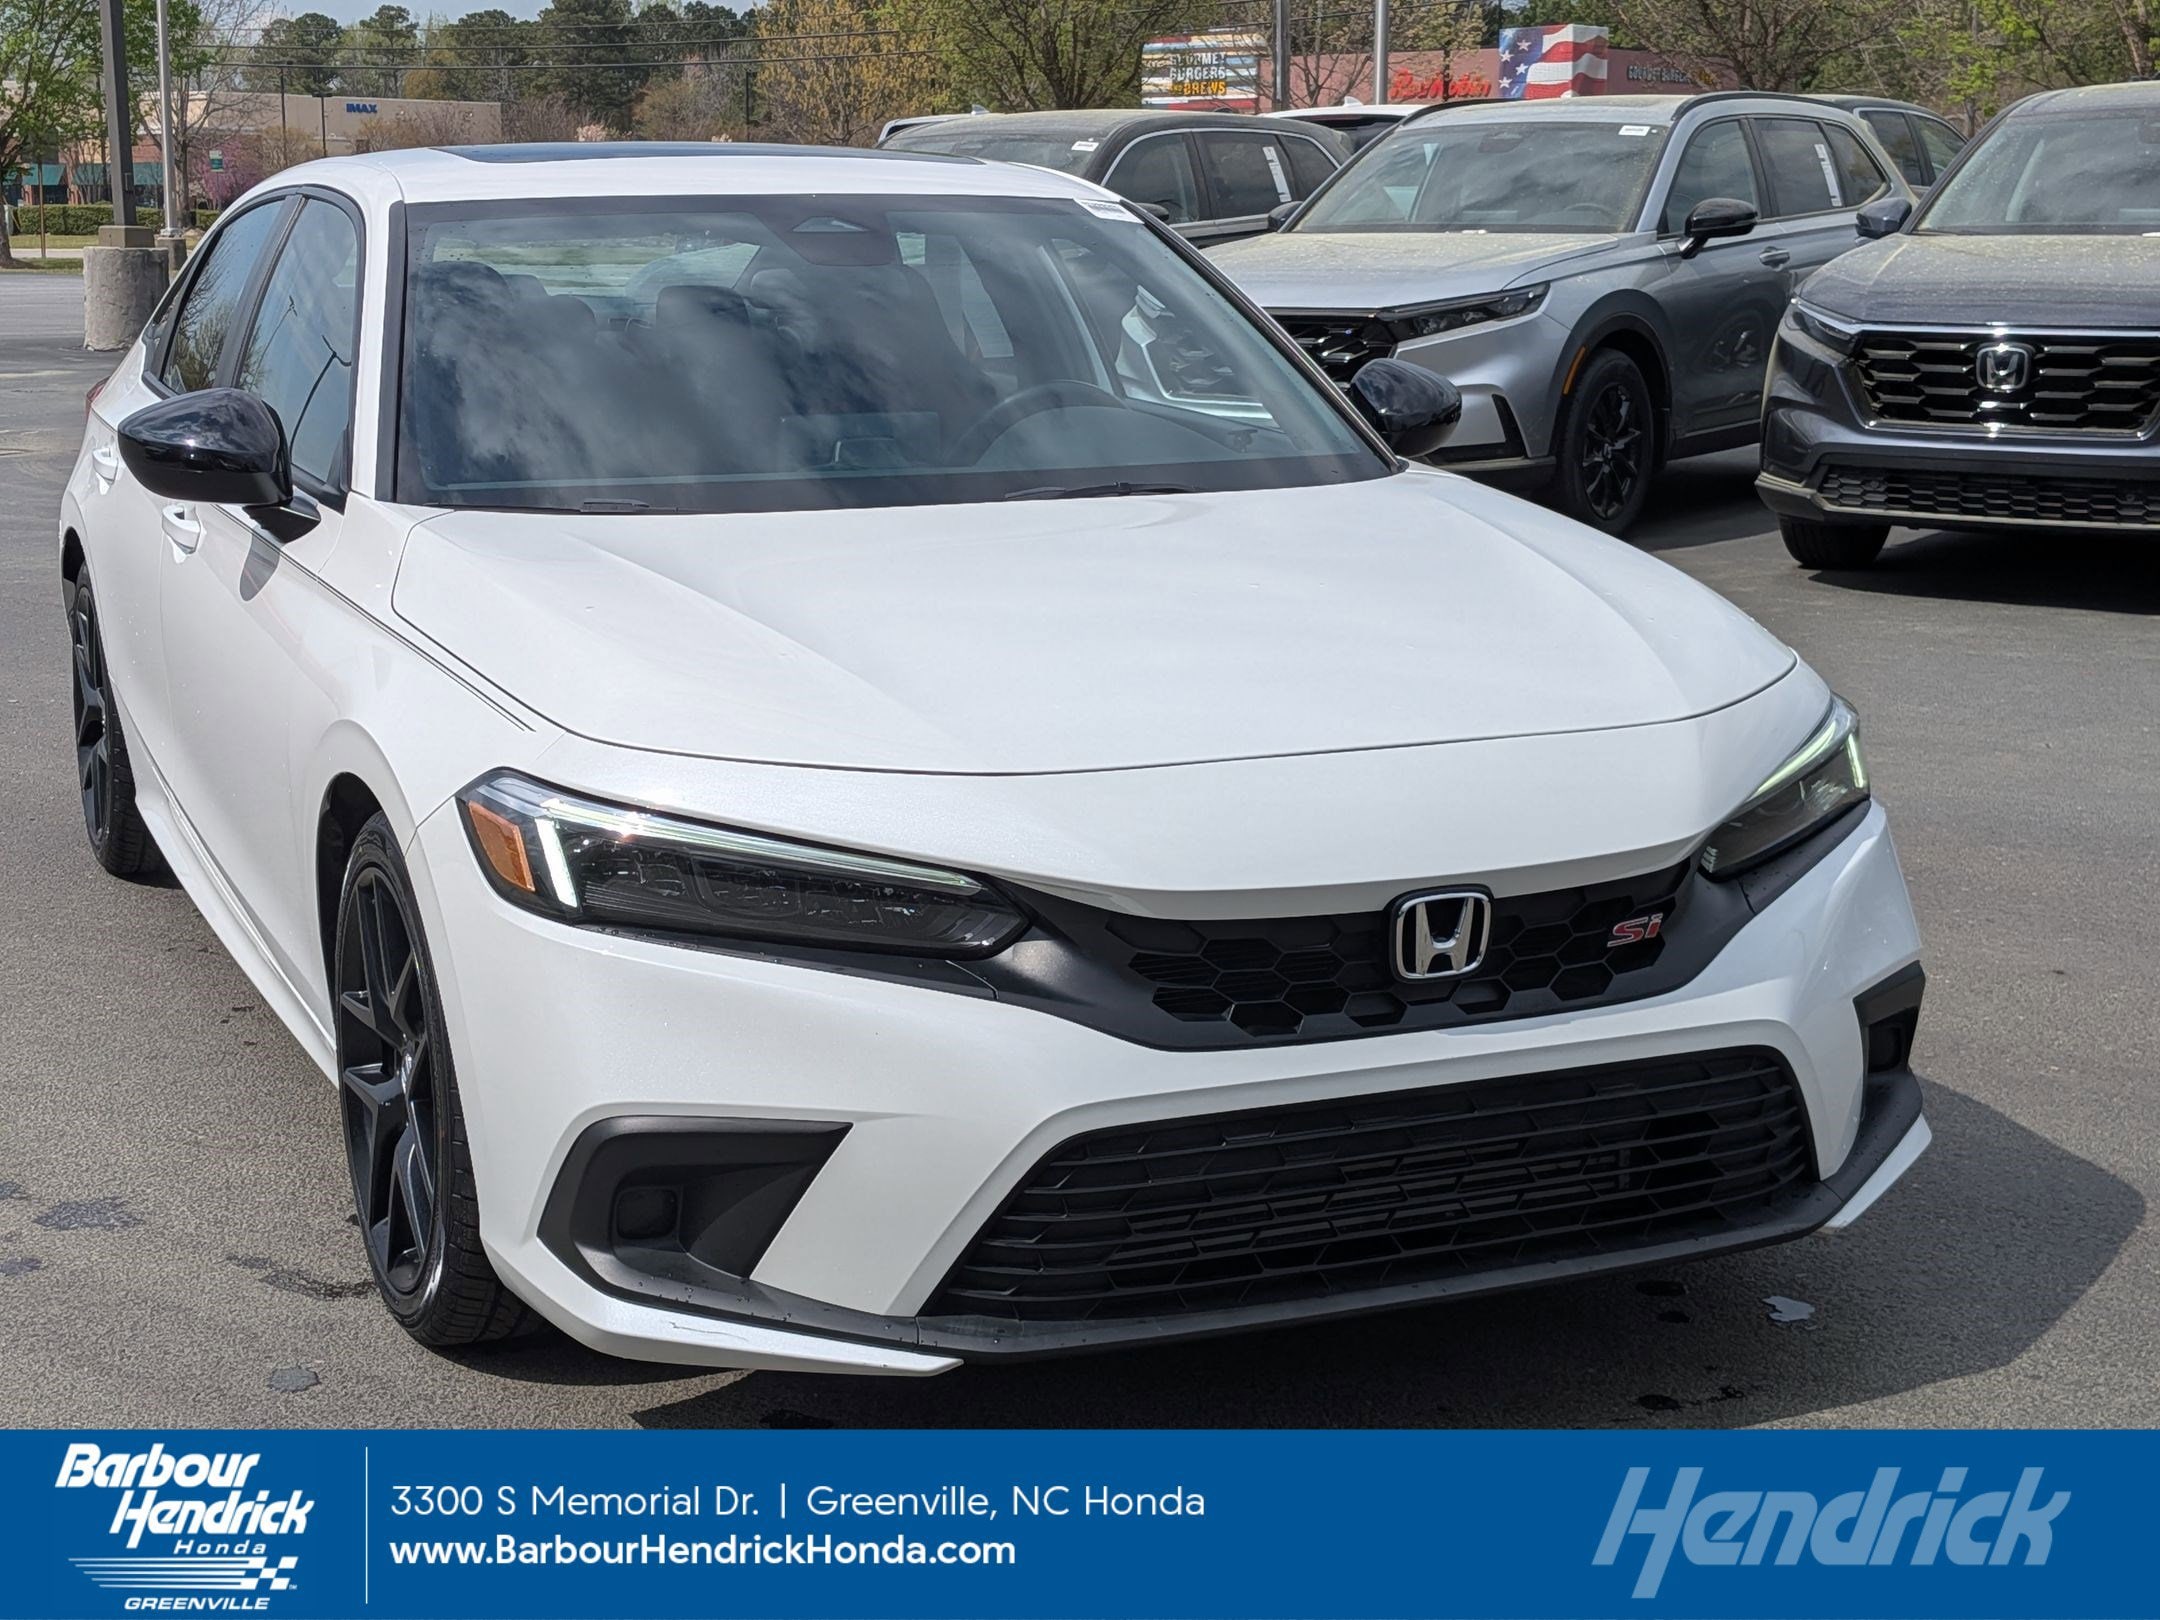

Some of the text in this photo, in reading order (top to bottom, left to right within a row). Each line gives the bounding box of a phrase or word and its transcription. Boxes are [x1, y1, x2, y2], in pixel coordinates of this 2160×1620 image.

[1169, 66, 1226, 81] BURGERS
[1183, 81, 1227, 96] BREWS
[345, 103, 378, 114] IMAX
